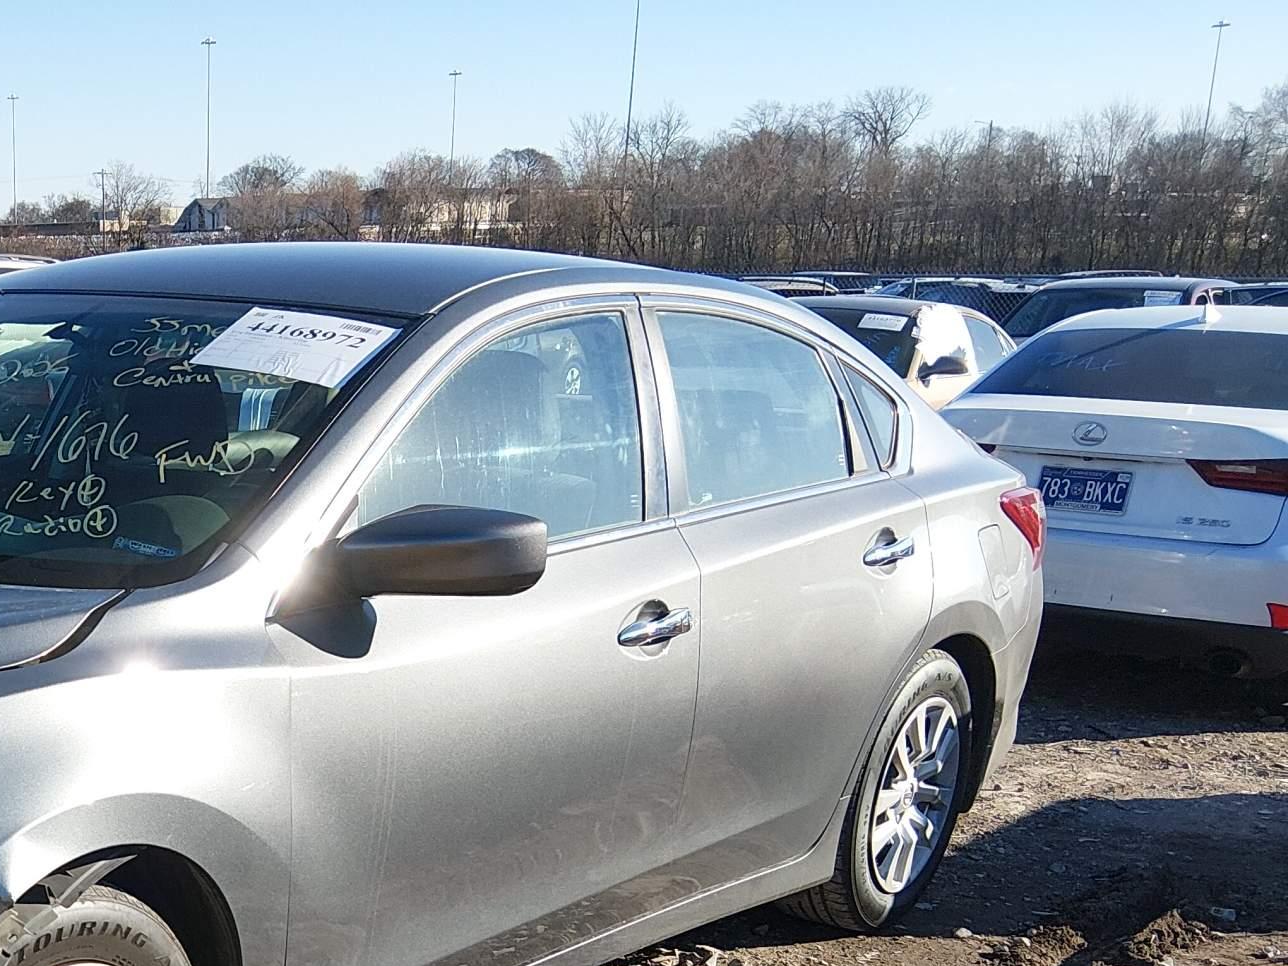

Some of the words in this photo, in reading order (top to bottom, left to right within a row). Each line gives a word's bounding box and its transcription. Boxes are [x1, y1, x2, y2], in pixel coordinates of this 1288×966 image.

[246, 321, 368, 349] 44168972
[1041, 477, 1071, 499] 783
[1083, 480, 1127, 504] BKXC
[15, 920, 149, 965] TOURING
